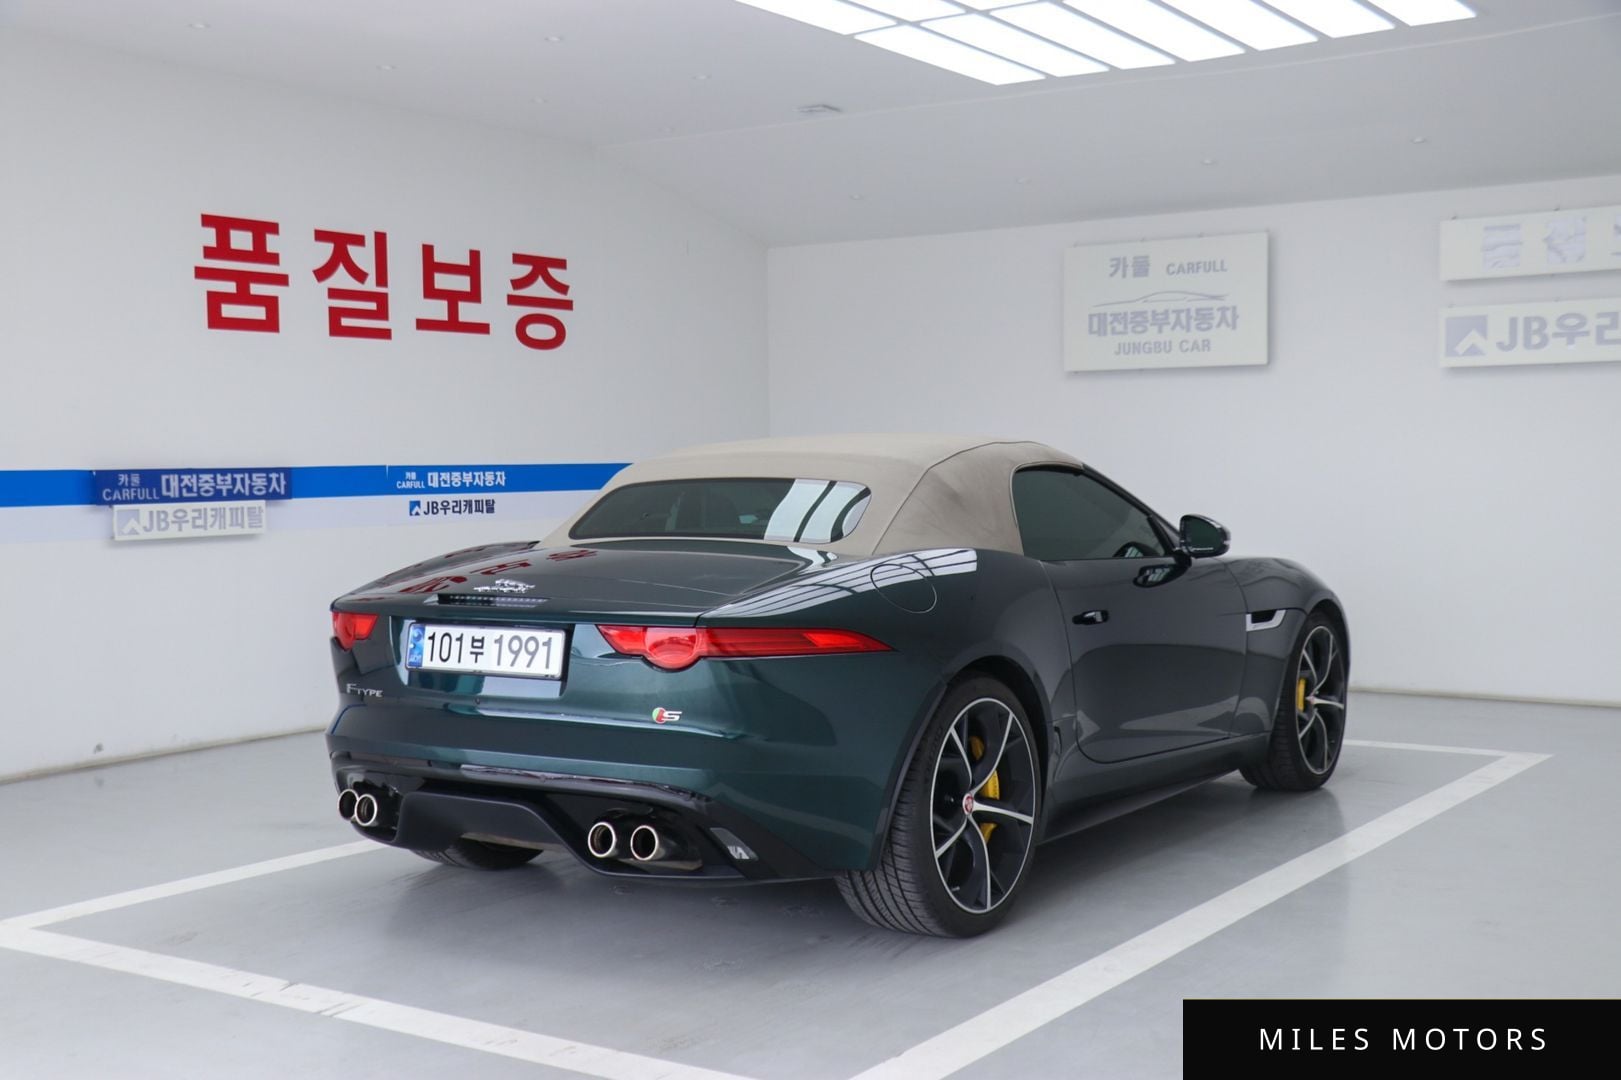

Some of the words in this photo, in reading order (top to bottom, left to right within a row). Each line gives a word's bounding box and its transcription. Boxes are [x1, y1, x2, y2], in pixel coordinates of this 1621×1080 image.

[1166, 259, 1228, 276] CARFULL
[194, 213, 574, 351] 품질보증
[1087, 305, 1240, 337] 대전중부자동차
[1114, 340, 1173, 356] JUNGBU
[1178, 338, 1212, 353] CAR
[160, 472, 287, 499] 대전중부자동차
[427, 470, 506, 488] 대전중부자동차
[102, 487, 160, 501] CARFULL
[423, 499, 496, 515] JB우리캐피탈
[143, 505, 264, 533] JB우리캐피탈
[428, 631, 485, 664] 101부
[494, 634, 553, 669] 1991
